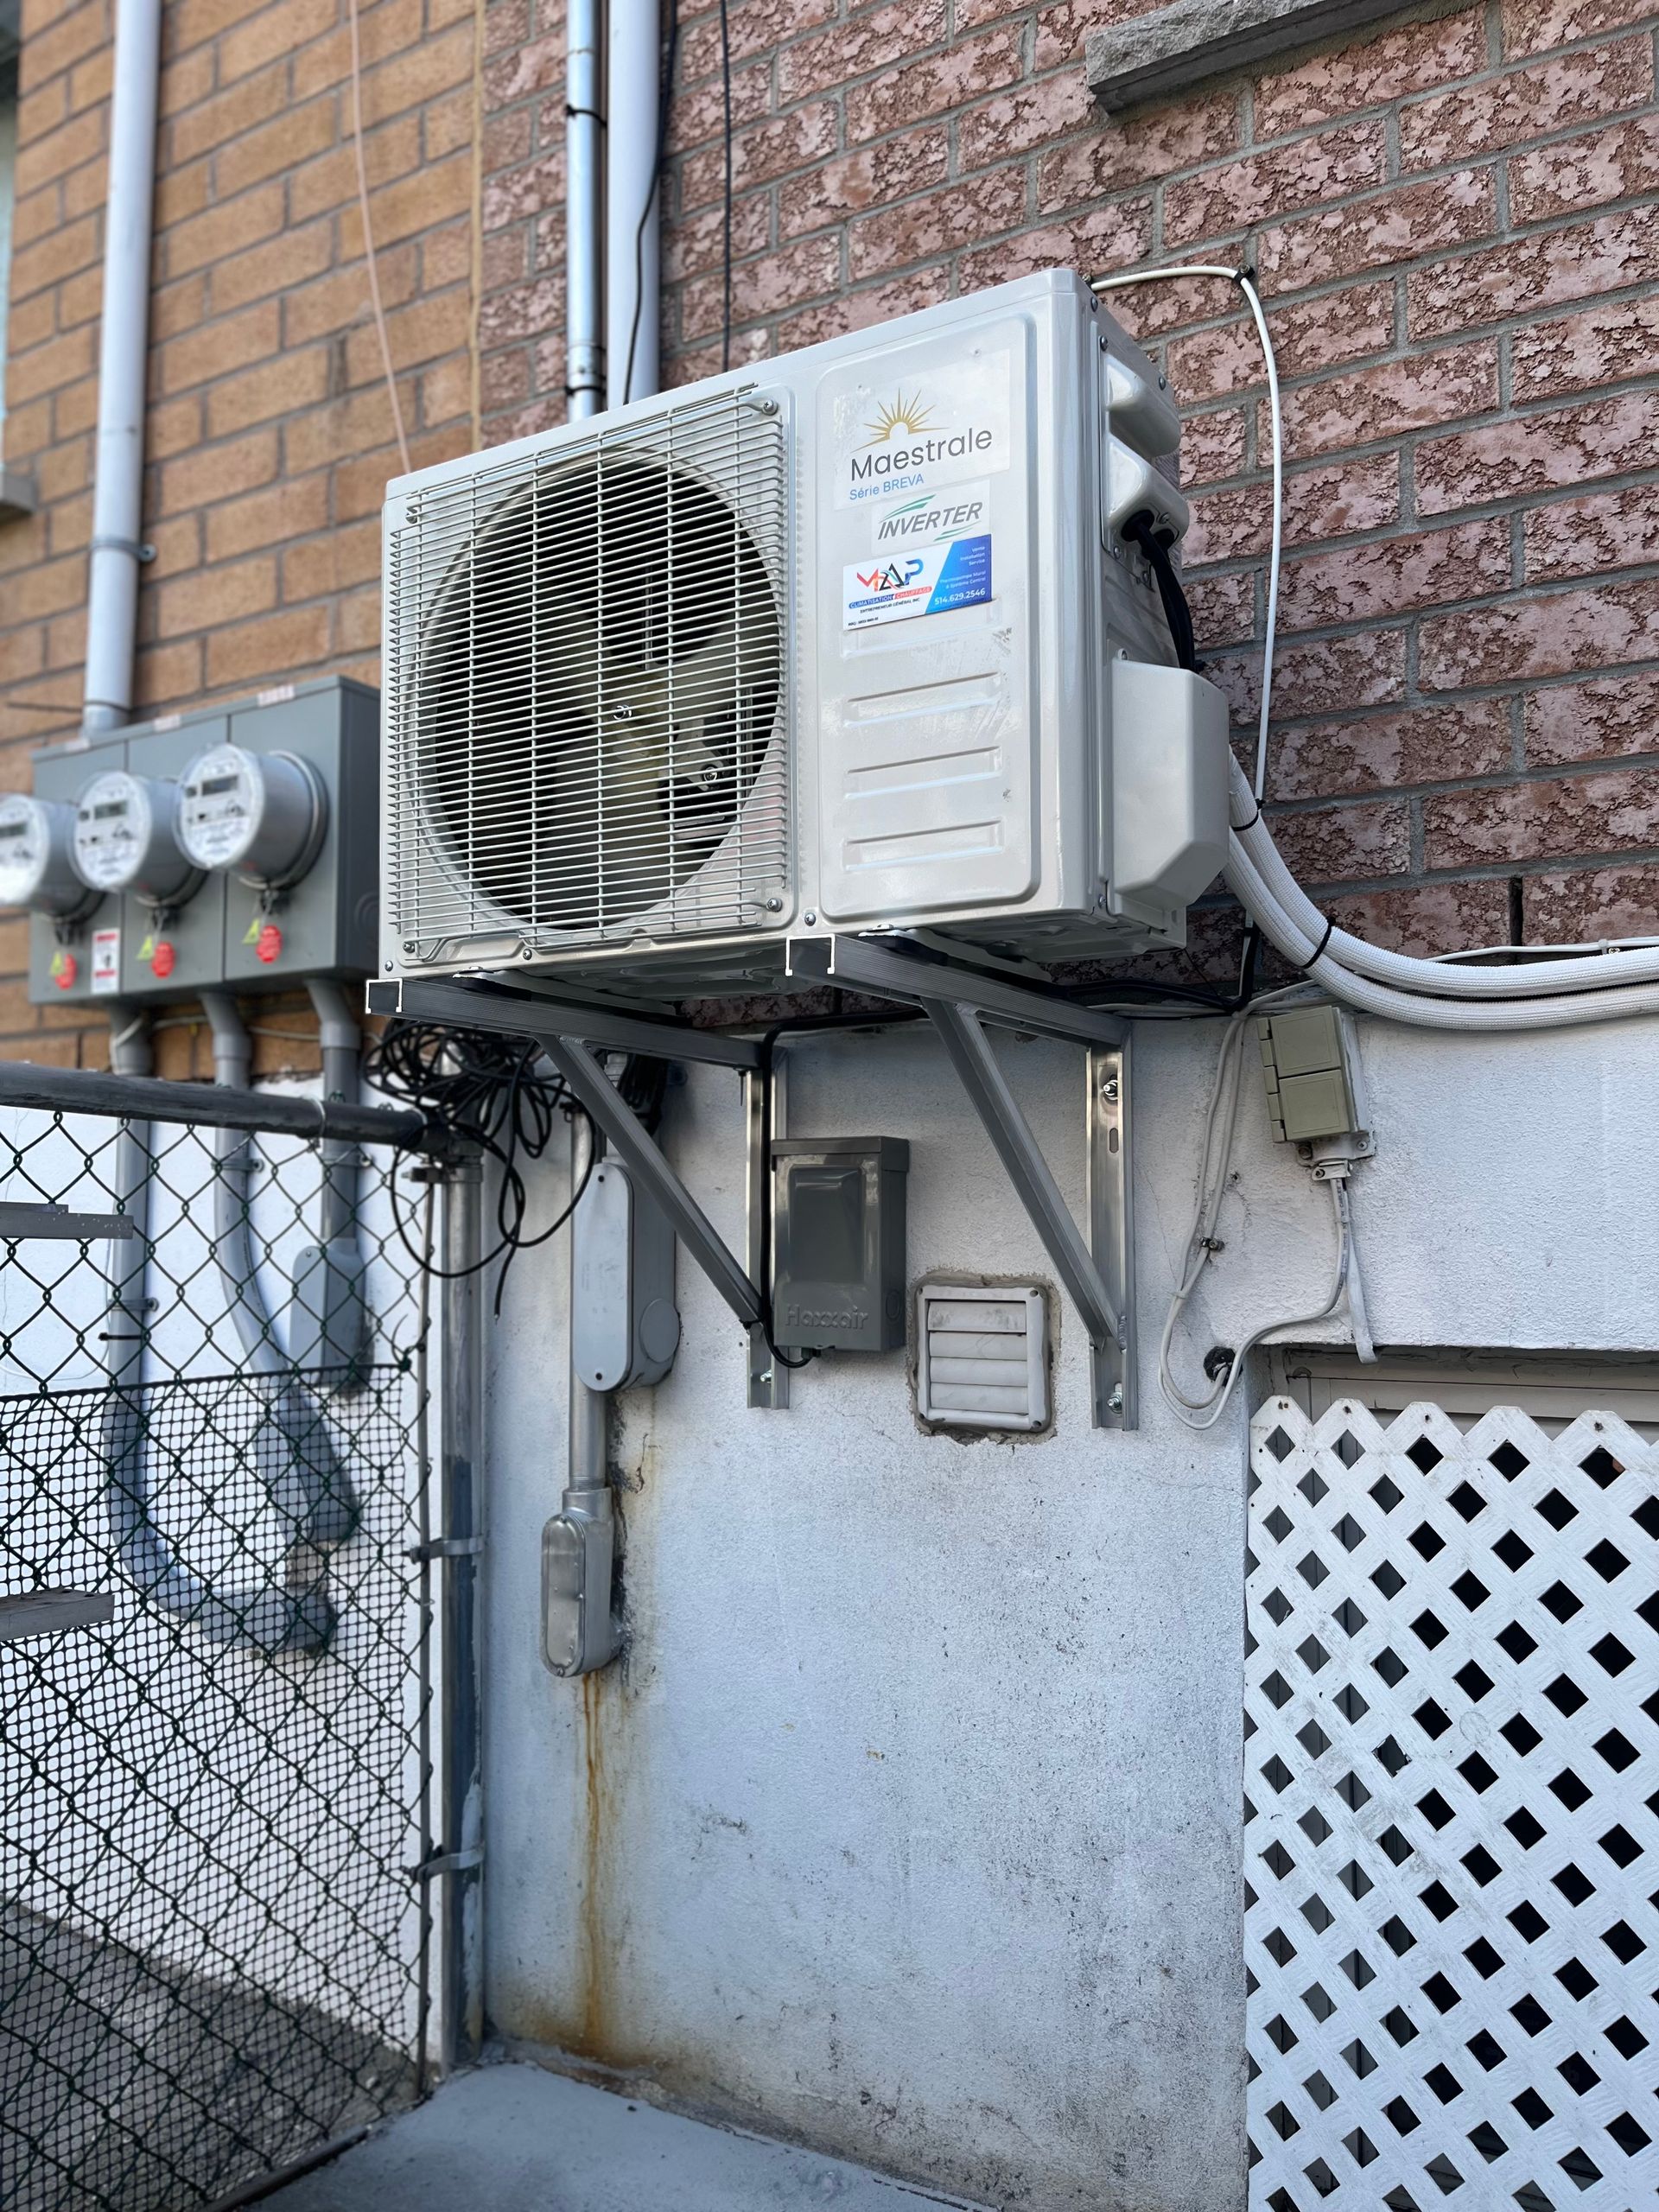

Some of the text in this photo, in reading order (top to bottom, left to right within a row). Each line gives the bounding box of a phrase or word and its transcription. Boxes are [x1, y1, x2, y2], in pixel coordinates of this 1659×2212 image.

[851, 428, 993, 481] Maestrale
[849, 473, 925, 501] Série BREVA
[877, 501, 983, 540] INVERTER
[849, 587, 931, 609] CLIMATISATION CHAUFFAGE
[934, 588, 986, 605] 514.629.2546
[785, 1305, 868, 1330] Haxxair
